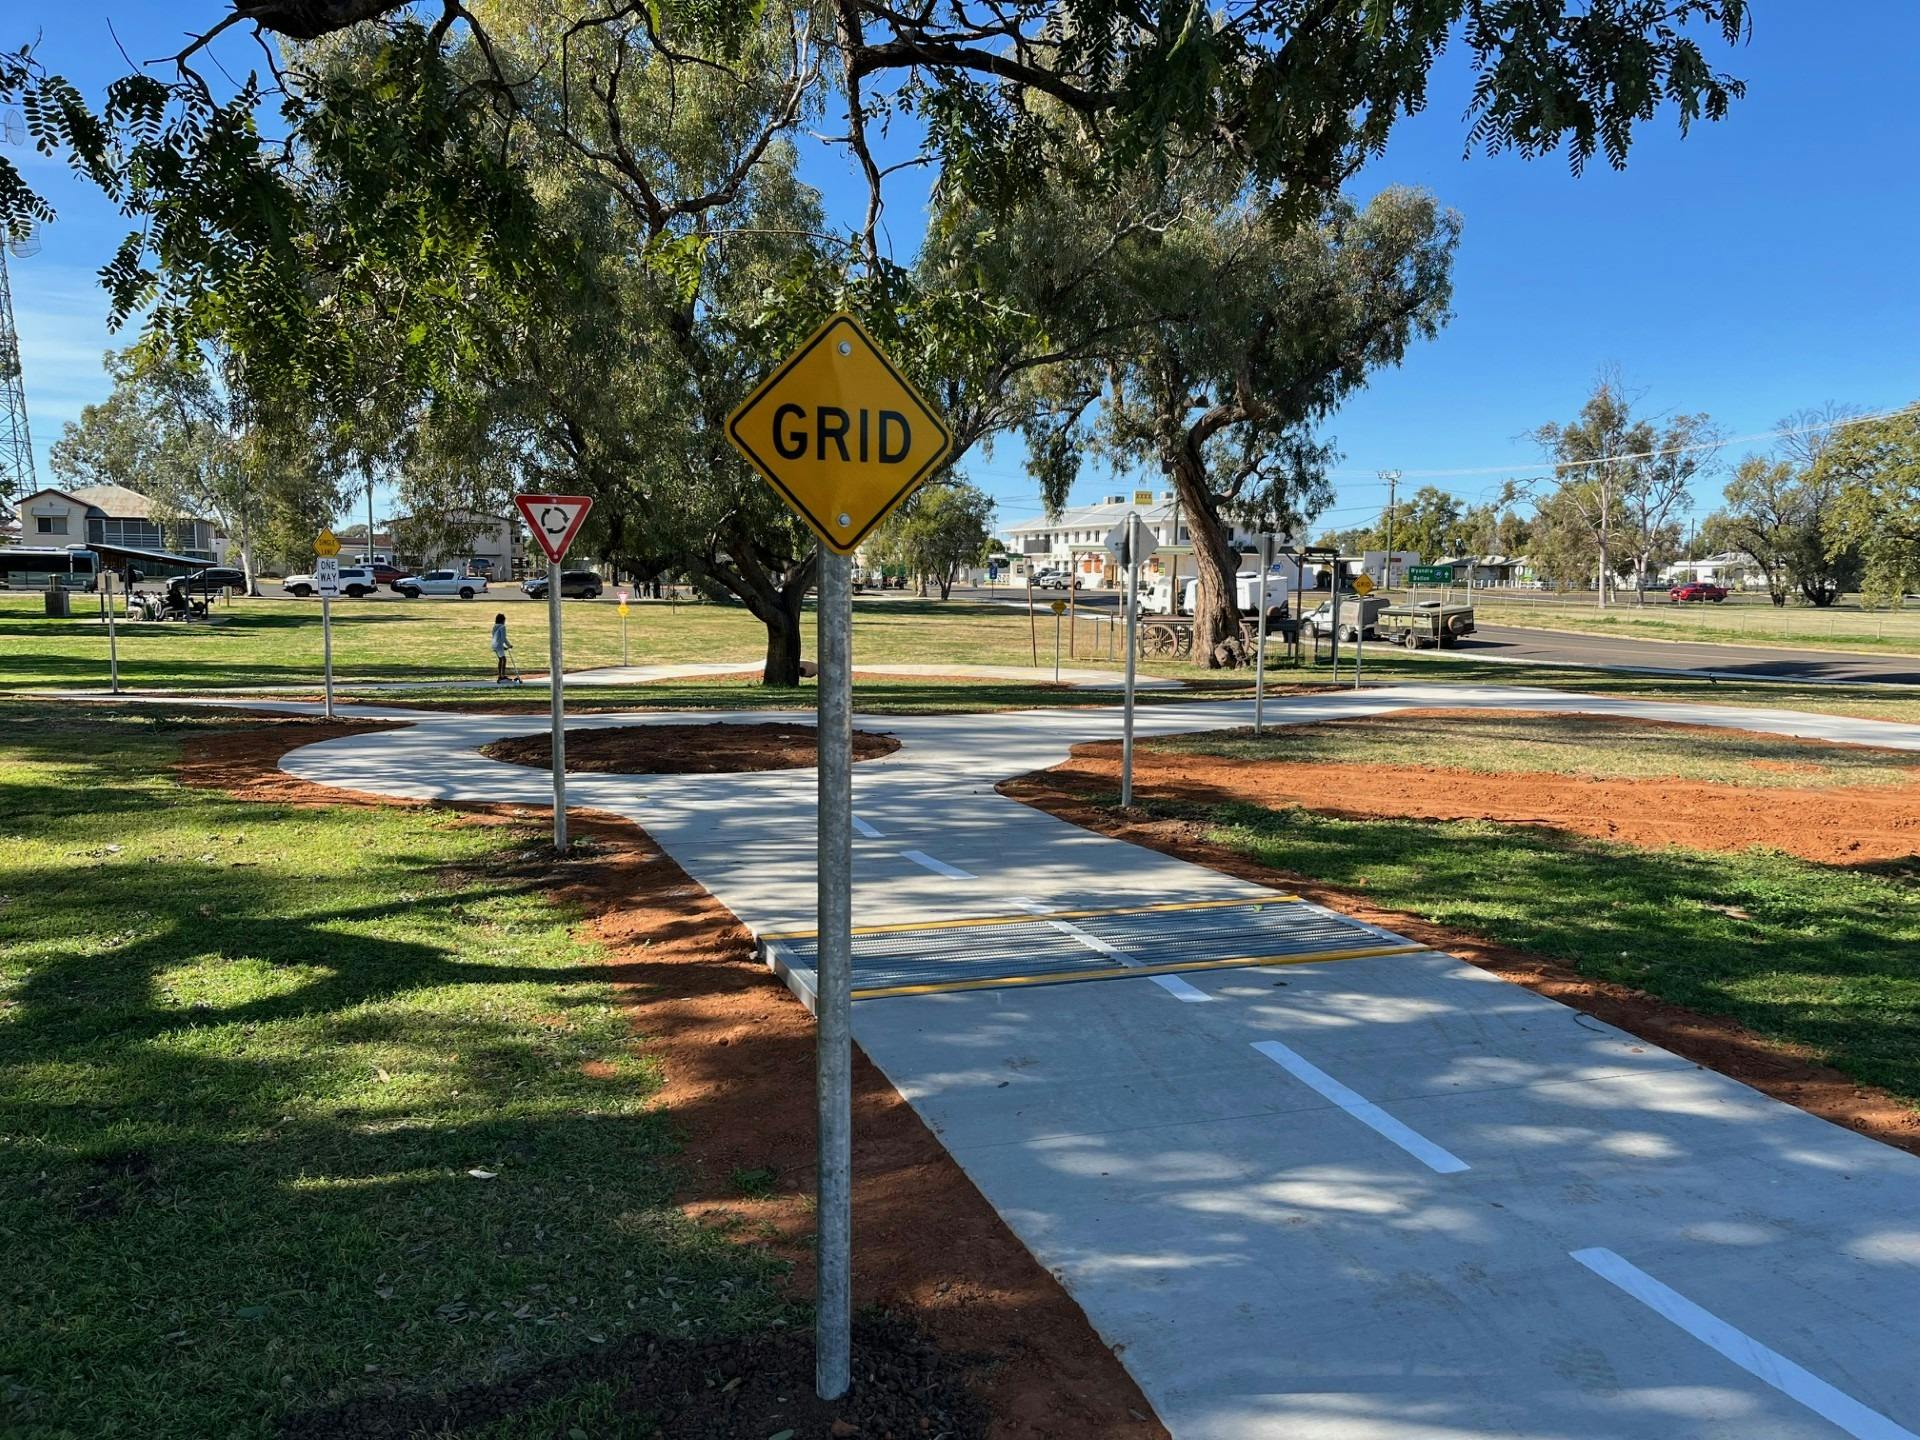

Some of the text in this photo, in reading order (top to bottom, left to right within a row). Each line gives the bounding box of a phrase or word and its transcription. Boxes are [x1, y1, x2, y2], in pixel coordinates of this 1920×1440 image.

[772, 403, 912, 464] GRID
[321, 561, 336, 570] ONE
[320, 573, 336, 582] WAY
